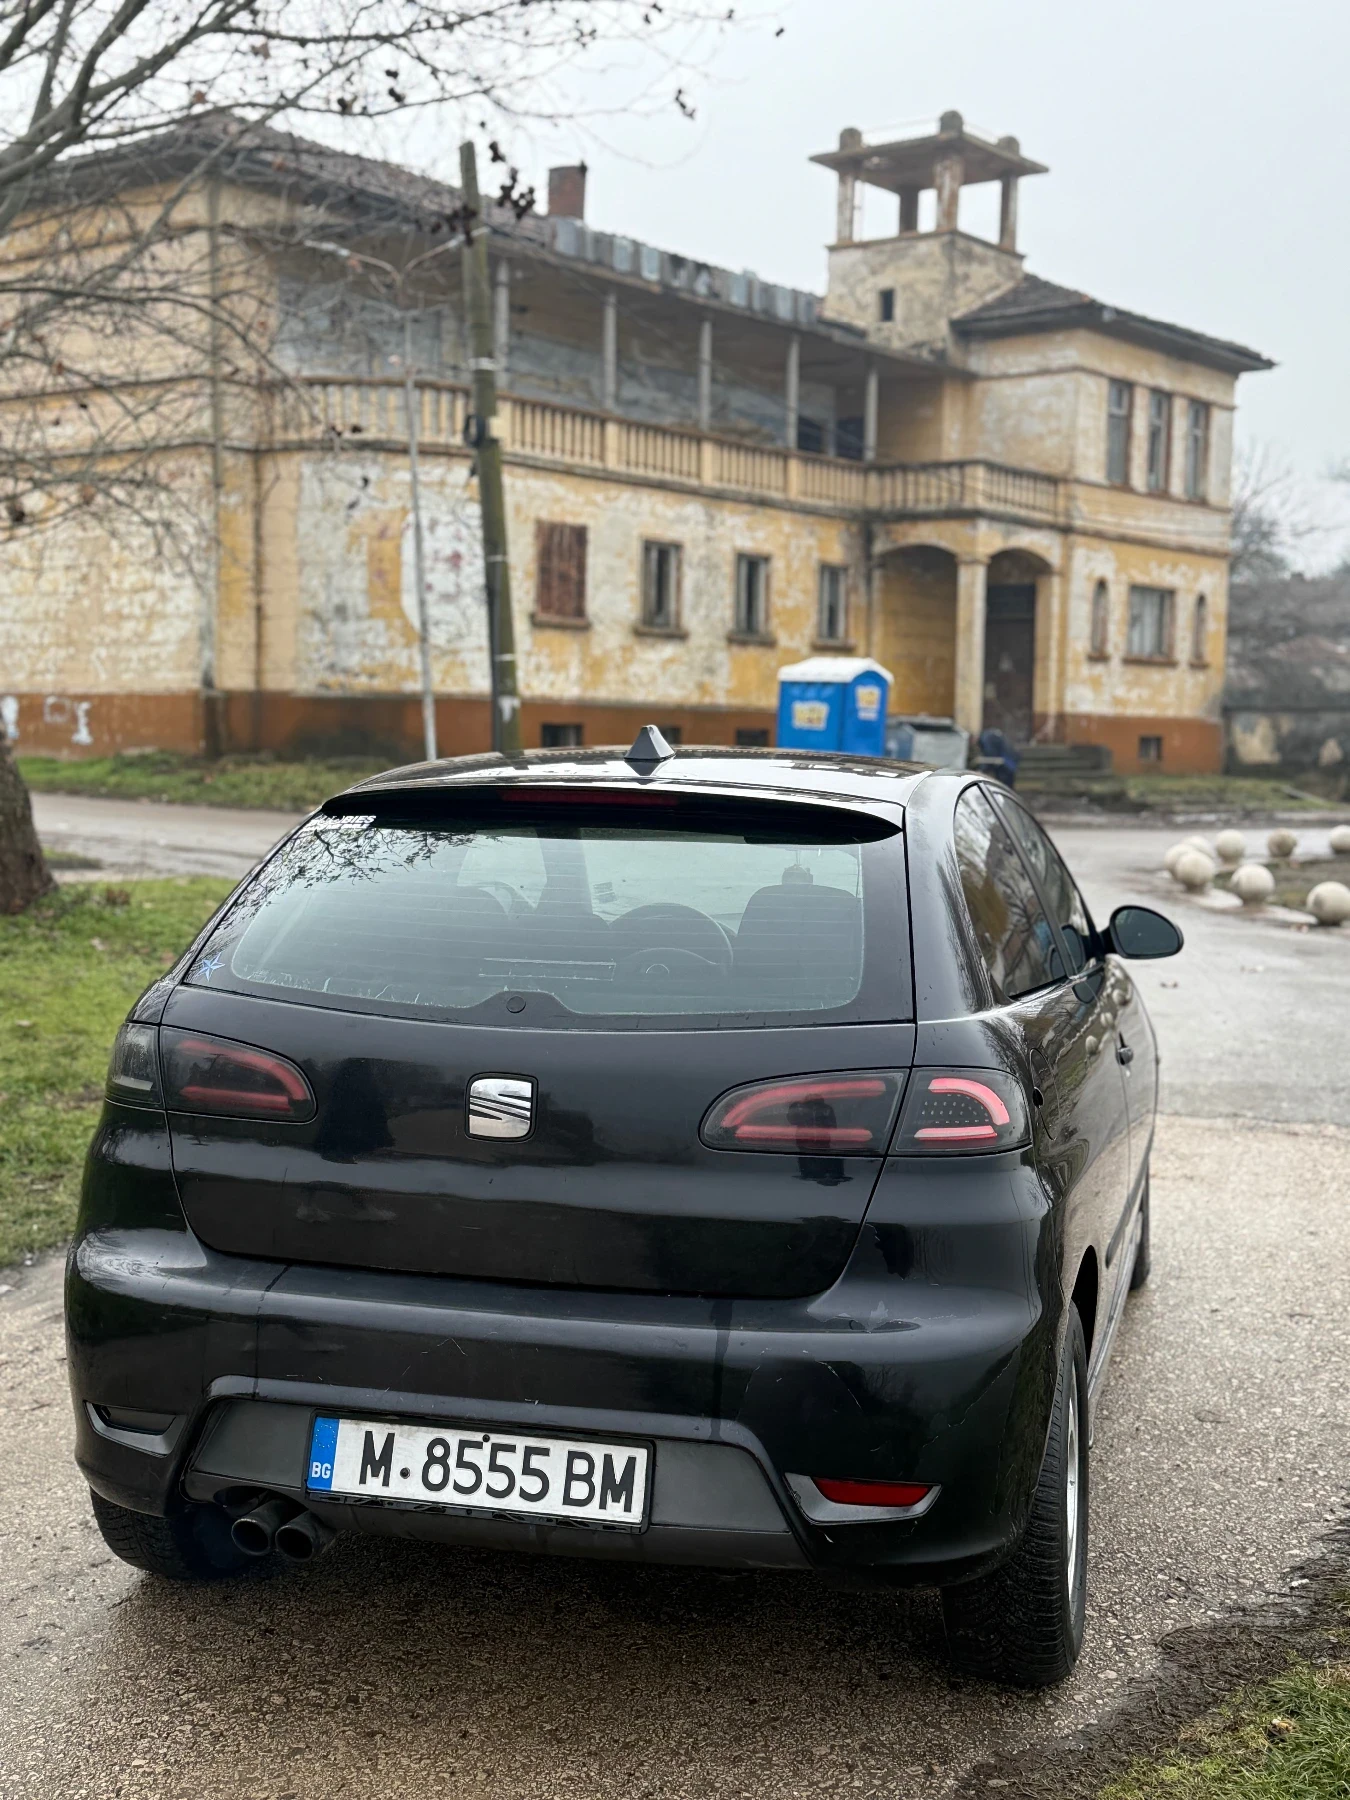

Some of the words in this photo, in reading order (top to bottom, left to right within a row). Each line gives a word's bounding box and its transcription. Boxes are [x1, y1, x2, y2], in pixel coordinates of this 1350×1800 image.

[311, 1461, 332, 1479] BG
[358, 1430, 396, 1487] M
[421, 1437, 551, 1503] 8555
[562, 1450, 637, 1513] BM
